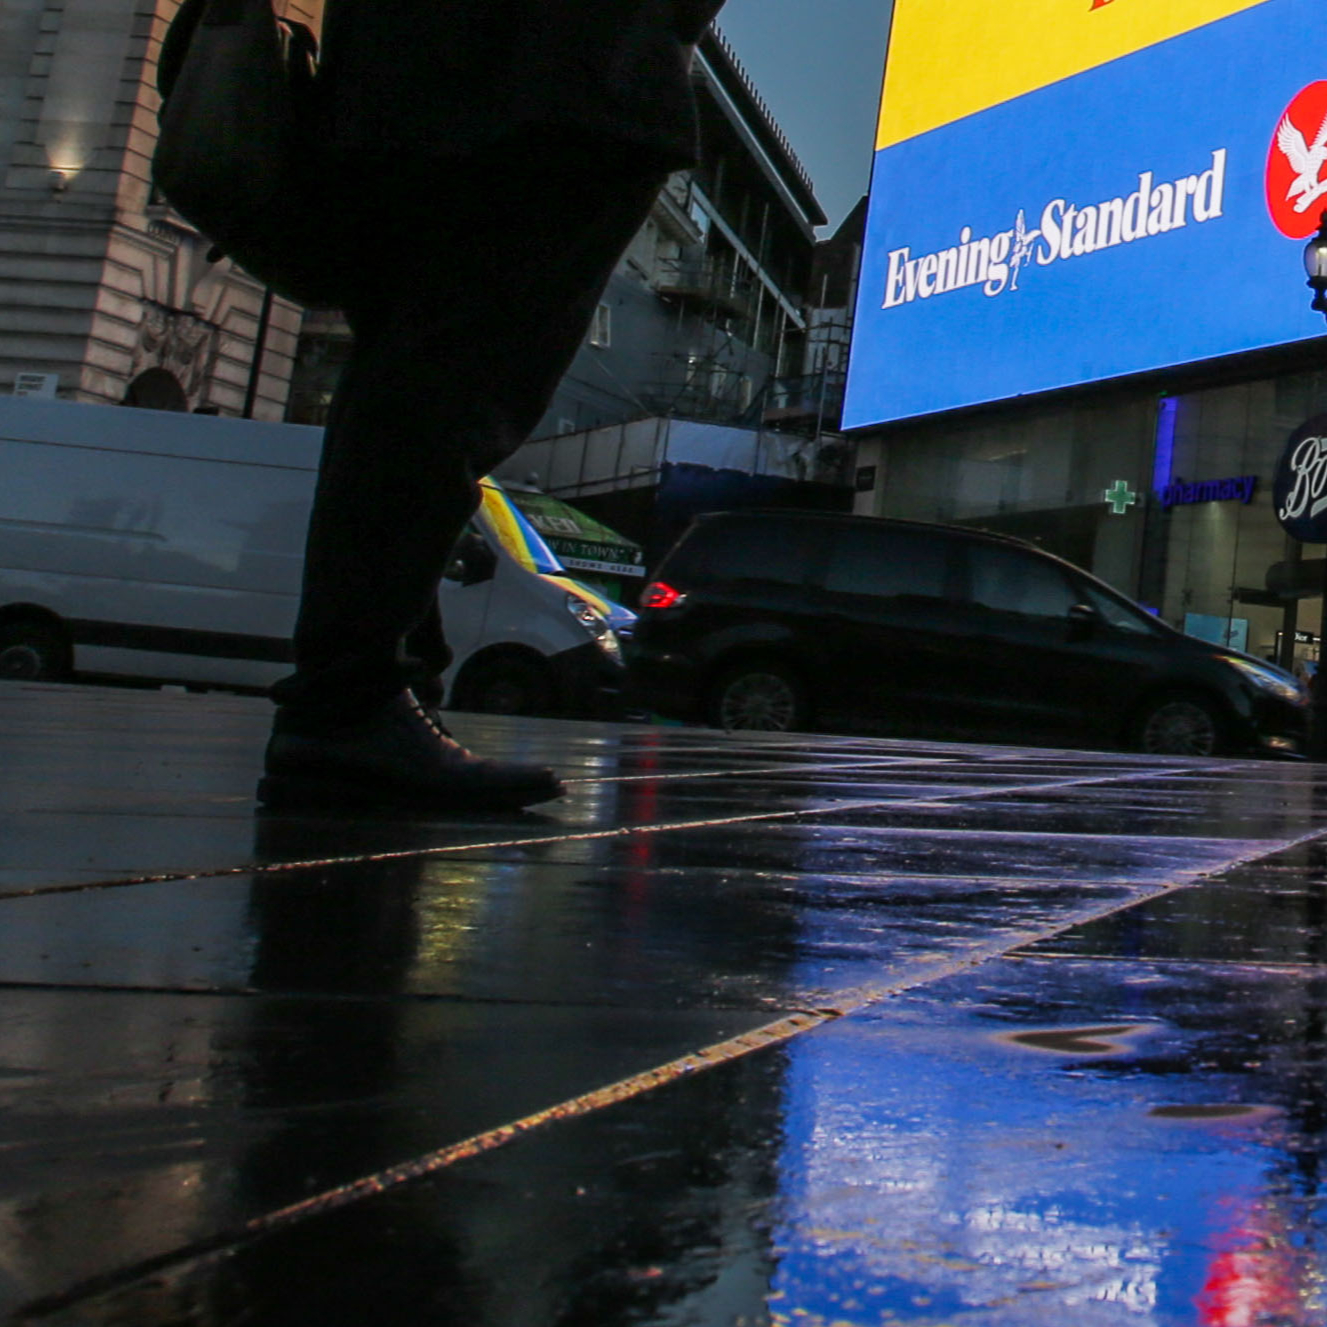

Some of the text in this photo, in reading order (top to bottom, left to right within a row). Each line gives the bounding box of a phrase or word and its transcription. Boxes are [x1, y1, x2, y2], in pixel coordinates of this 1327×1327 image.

[881, 147, 1227, 310] Evening Standard
[1162, 476, 1258, 512] pharmacy
